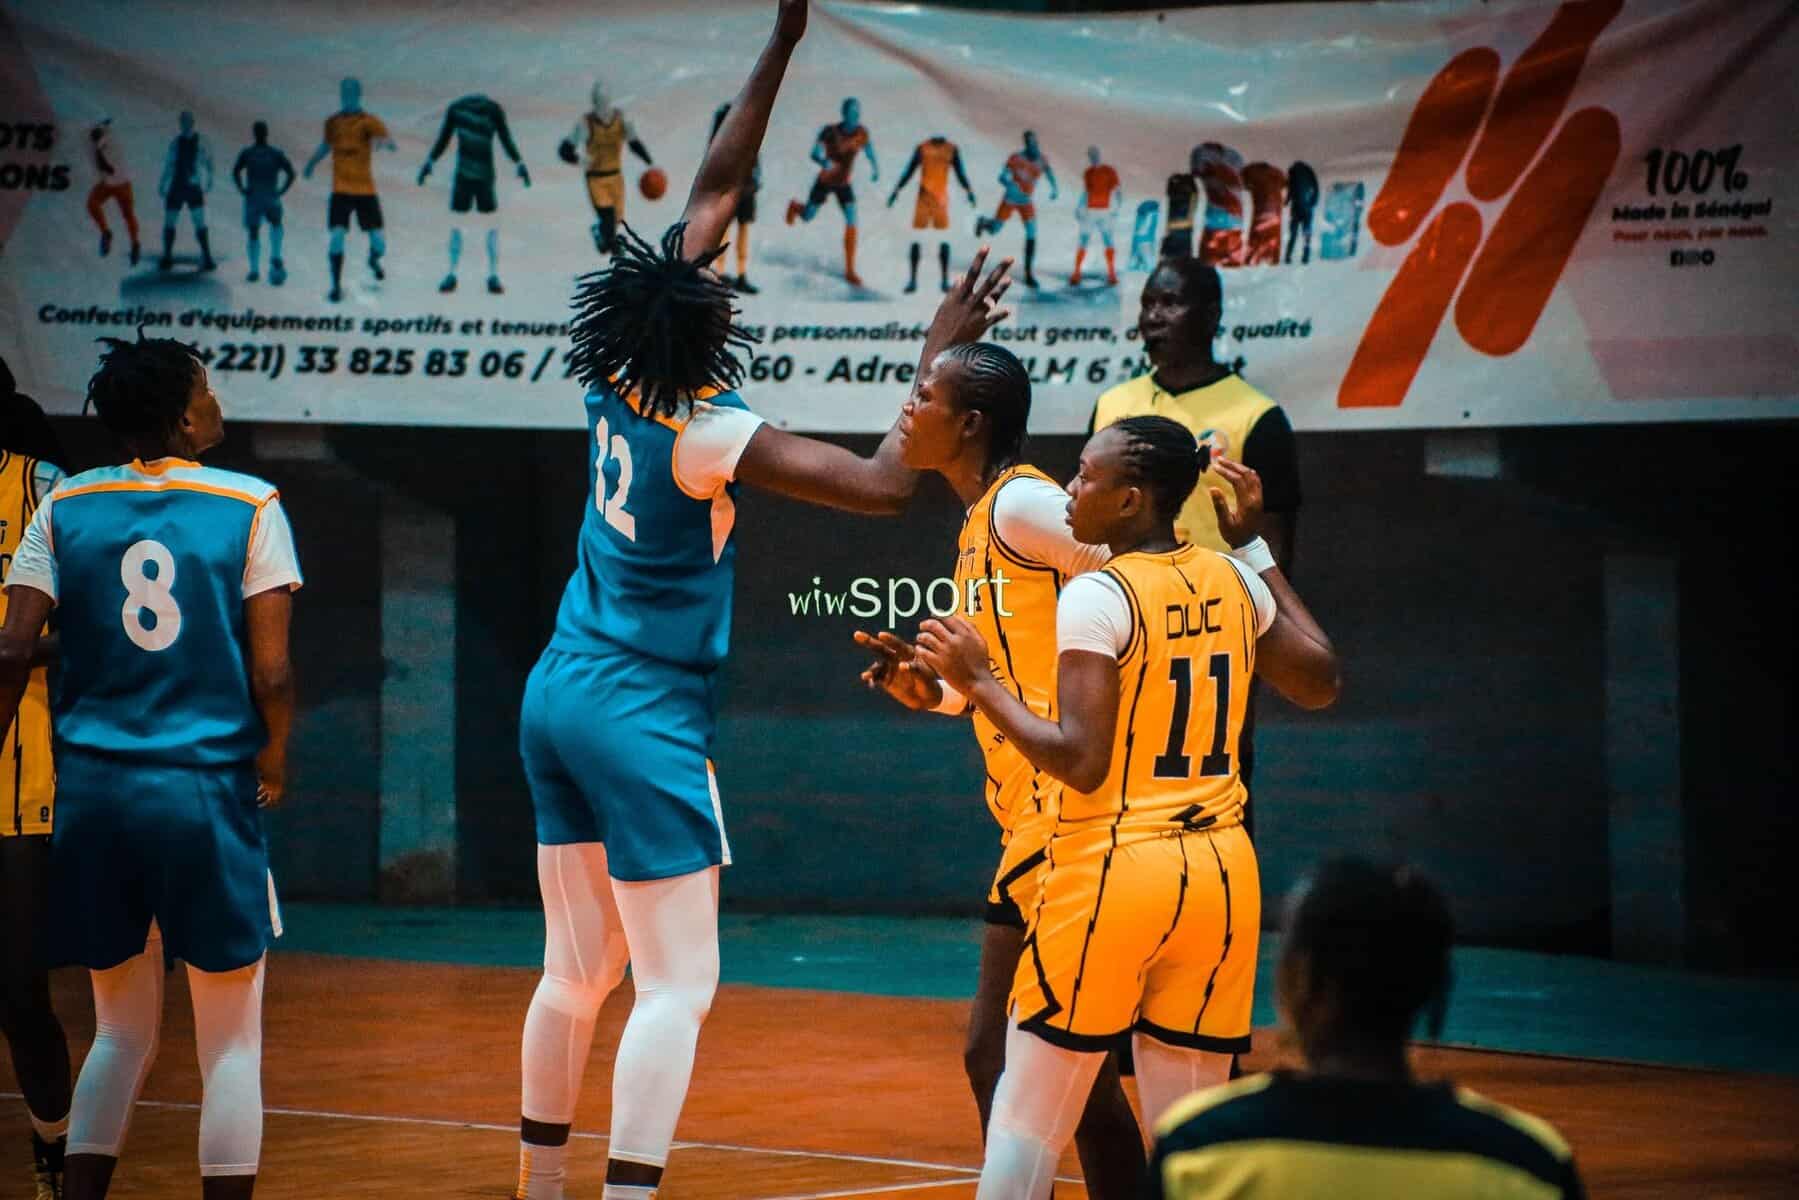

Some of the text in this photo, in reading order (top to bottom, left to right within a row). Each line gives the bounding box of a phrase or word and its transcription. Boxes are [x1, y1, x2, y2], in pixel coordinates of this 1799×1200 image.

[1643, 144, 1748, 195] 100%
[38, 304, 568, 337] Confection d'équipements sportifs et tenues
[771, 321, 927, 343] personnalisé
[991, 325, 1038, 341] tout
[1045, 325, 1118, 346] genre,
[1232, 316, 1312, 342] qualité
[294, 347, 339, 374] 33
[348, 347, 415, 376] 825
[424, 348, 469, 377] 83
[480, 350, 526, 378] 06
[531, 347, 556, 382] /
[825, 355, 916, 383] Adre
[1020, 356, 1078, 384] LM
[1087, 357, 1110, 384] 6
[595, 416, 636, 543] 12
[120, 539, 182, 652] 8
[1166, 598, 1222, 640] DUC
[1153, 652, 1231, 779] 11
